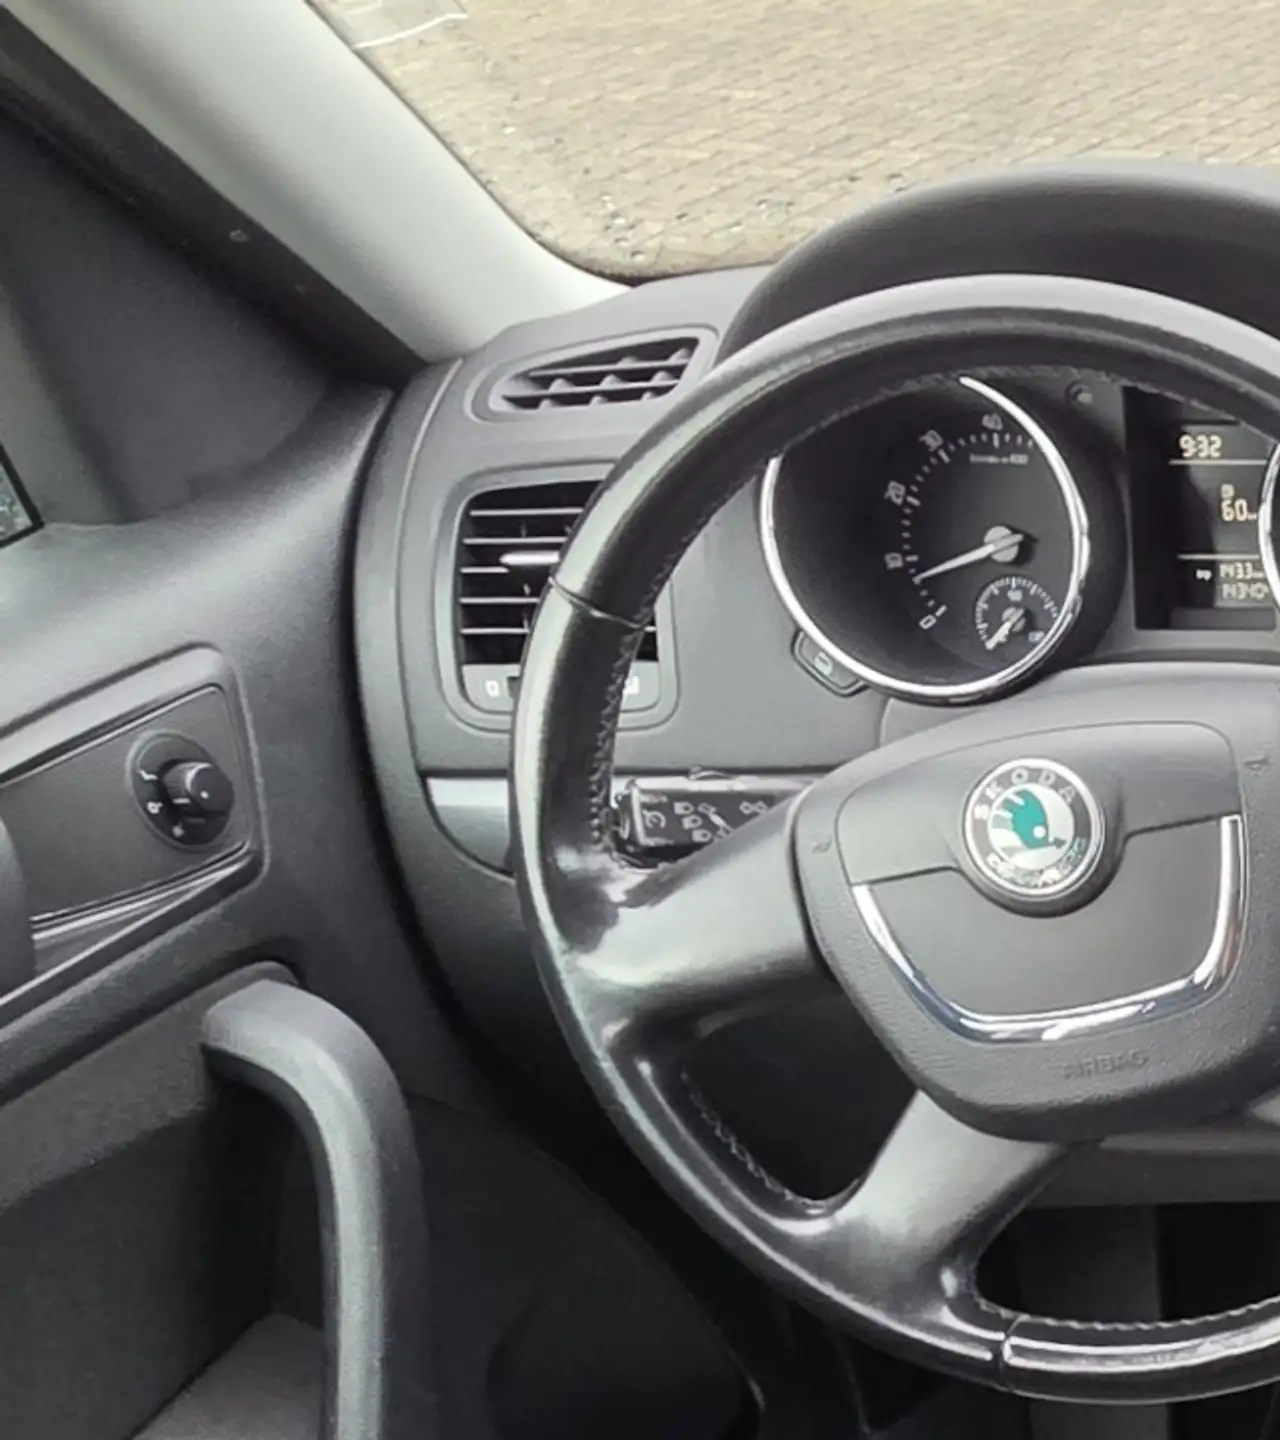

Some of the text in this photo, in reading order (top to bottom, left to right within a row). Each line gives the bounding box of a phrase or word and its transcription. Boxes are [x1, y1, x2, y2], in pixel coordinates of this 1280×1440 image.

[884, 480, 906, 505] 20
[1221, 498, 1248, 521] 60
[919, 614, 937, 630] 0
